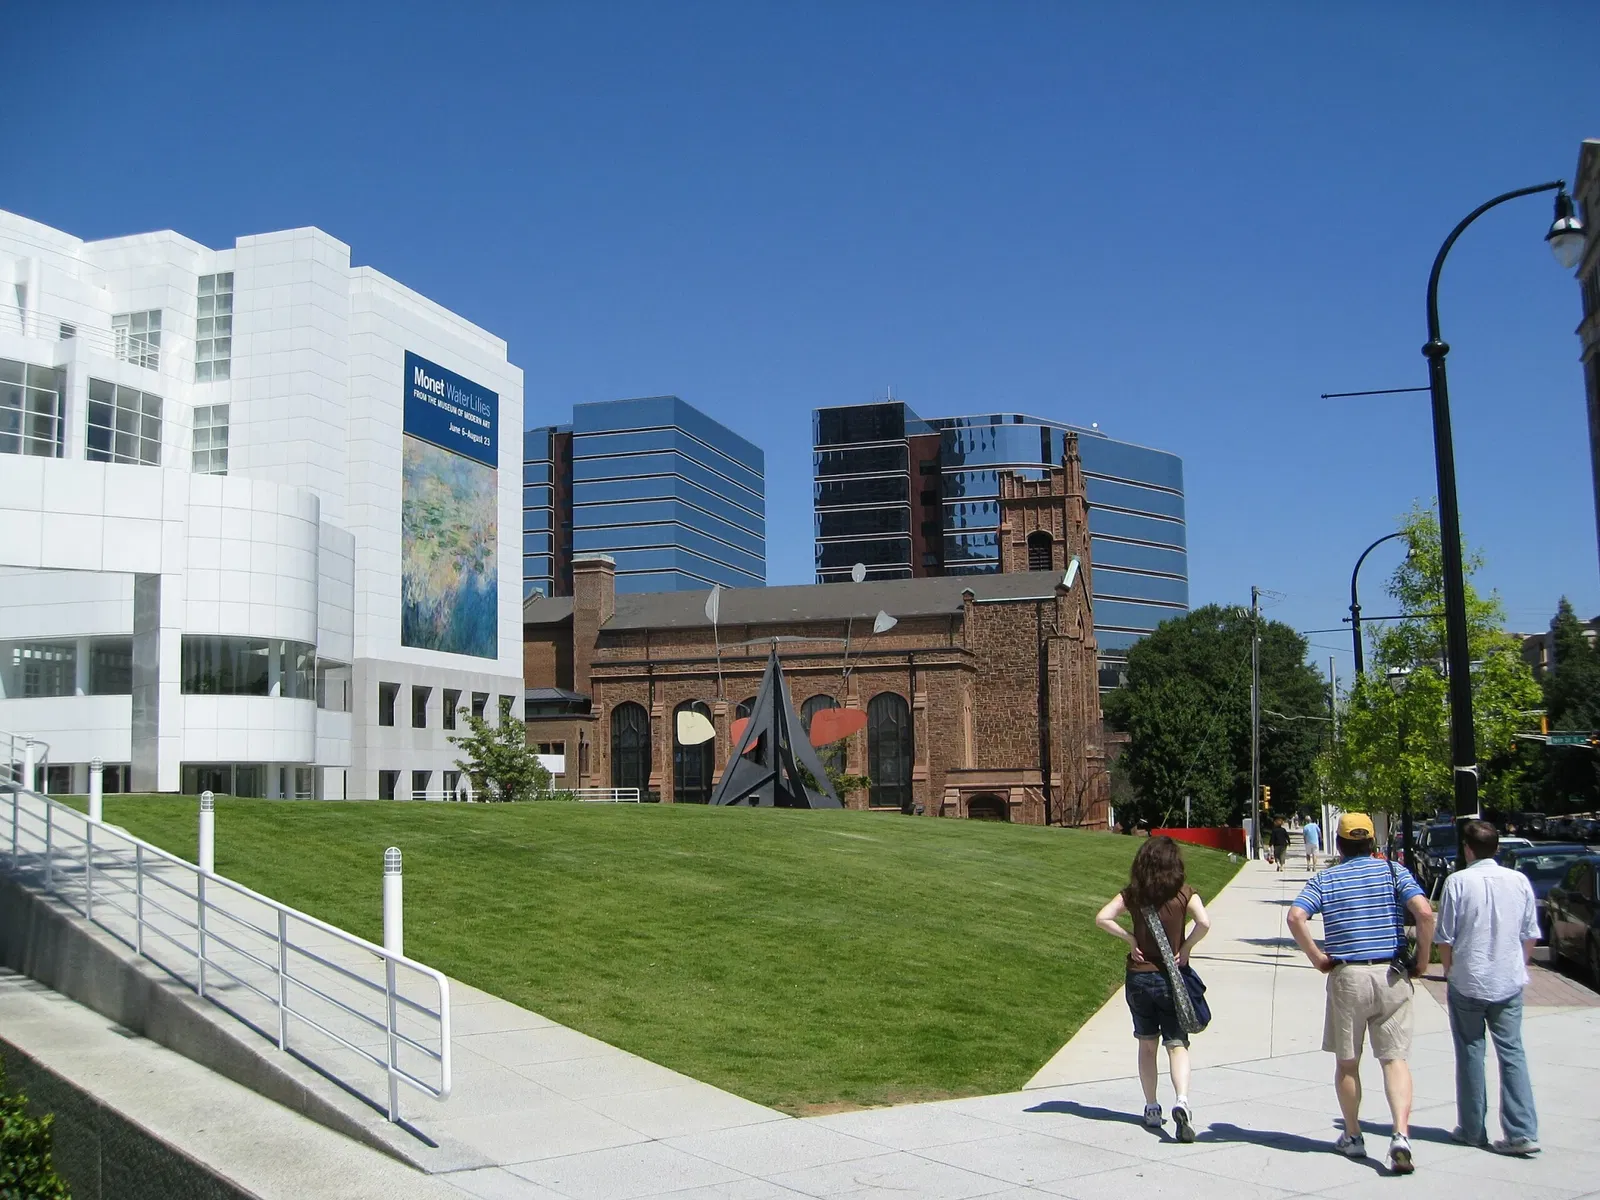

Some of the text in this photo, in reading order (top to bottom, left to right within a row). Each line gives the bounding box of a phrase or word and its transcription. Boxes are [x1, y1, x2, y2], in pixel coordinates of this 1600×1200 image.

[415, 366, 444, 397] Monet
[414, 389, 491, 429] FROM THE MUSEUM OF MODERN ART
[449, 422, 461, 434] June
[483, 437, 491, 446] 23
